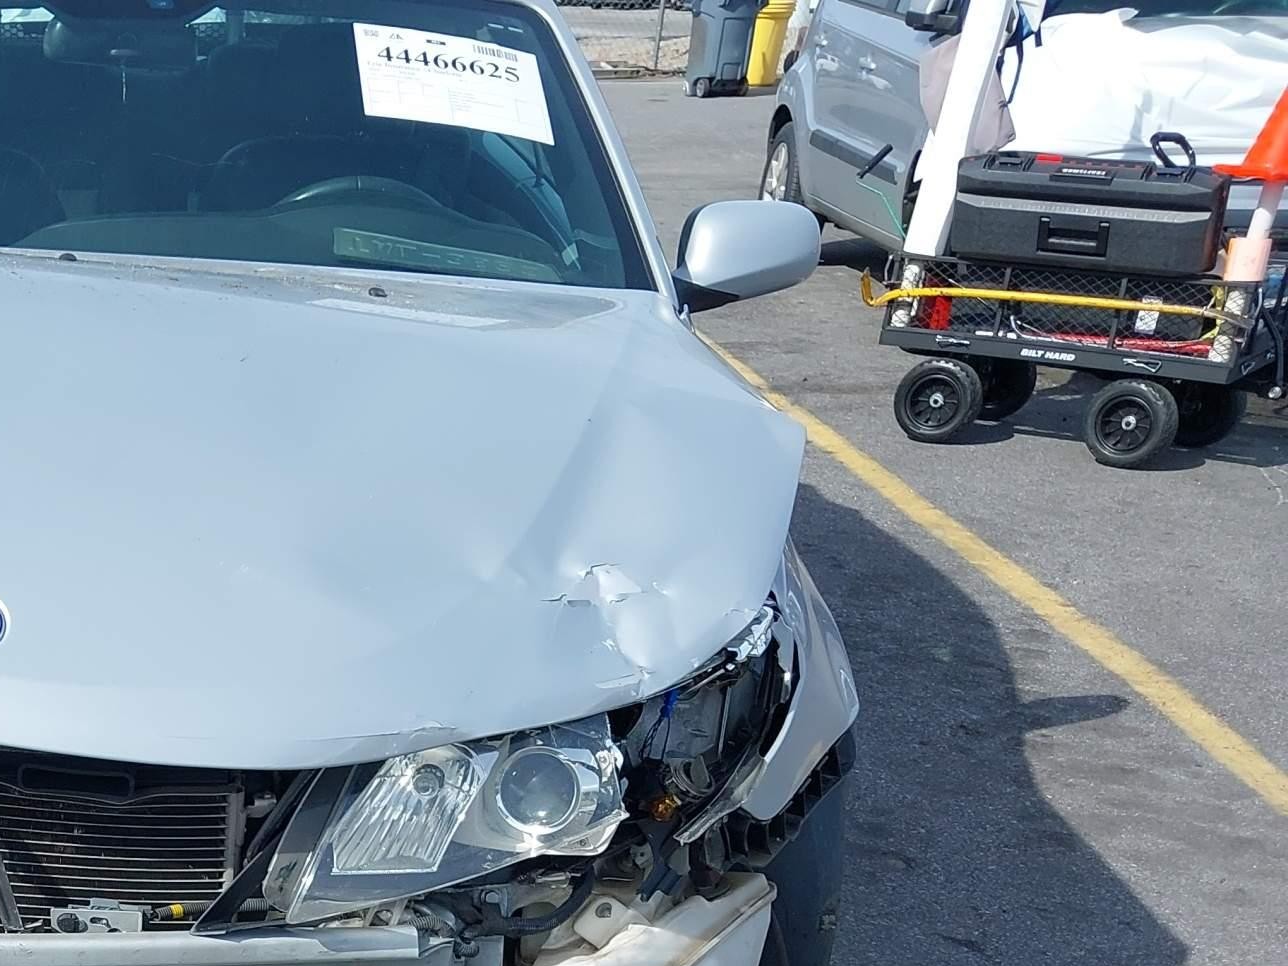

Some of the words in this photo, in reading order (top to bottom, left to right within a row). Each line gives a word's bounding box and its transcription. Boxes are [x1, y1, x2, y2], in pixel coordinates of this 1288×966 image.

[377, 46, 520, 82] 44466625
[1020, 348, 1045, 358] BILT
[1044, 351, 1076, 362] HARD
